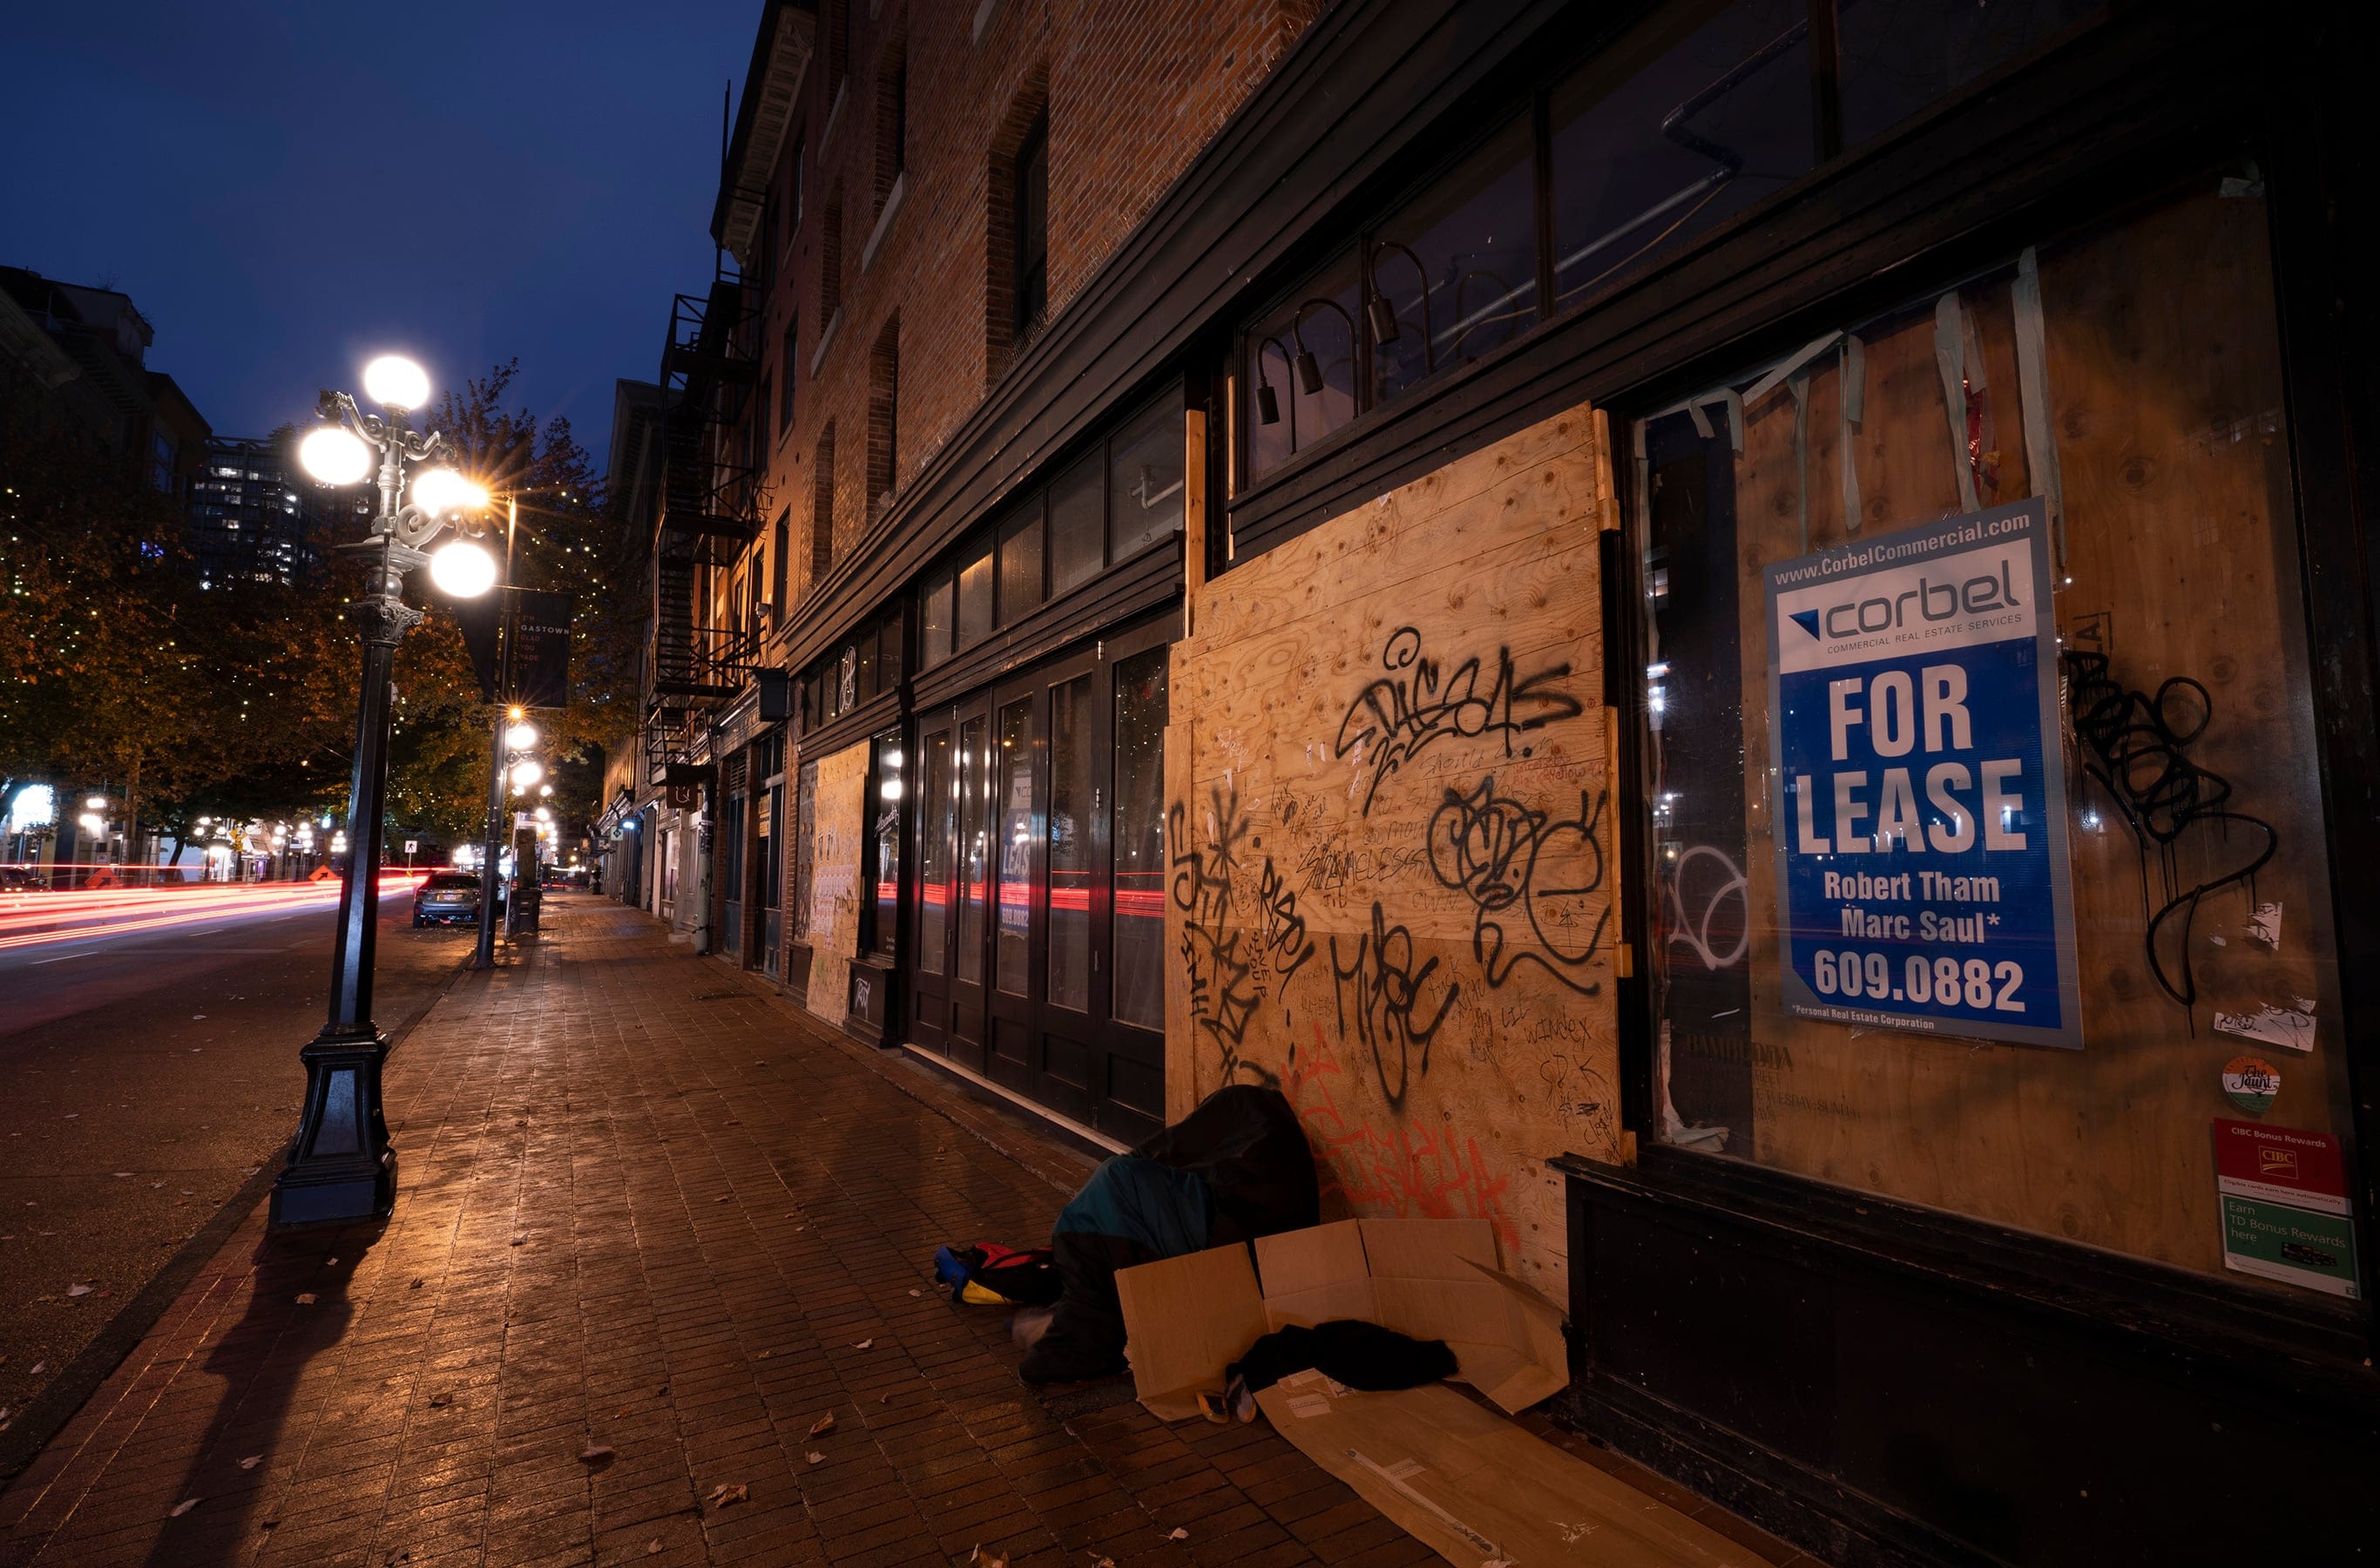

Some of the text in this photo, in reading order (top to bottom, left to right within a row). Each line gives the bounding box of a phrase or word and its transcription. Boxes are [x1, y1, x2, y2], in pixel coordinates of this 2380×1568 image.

[1775, 513, 2031, 586] www.CorbelCommercial.com
[1825, 559, 2022, 639] corbel
[520, 624, 570, 635] GASTOWN
[1827, 613, 2022, 655] COMMERCIAL REAL ESTATE SERVICES
[1829, 663, 1974, 761] FOR
[1795, 758, 2028, 855] LEASE
[1003, 844, 1031, 875] LEAS
[1824, 871, 2000, 902] Robert Tham
[1841, 909, 1910, 940] Marc
[1814, 950, 2025, 1013] 609.0882
[1831, 1008, 1849, 1020] Real
[1851, 1010, 1879, 1024] Estate
[1880, 1013, 1935, 1031] Corporation
[2231, 1072, 2275, 1091] Jaunt
[2243, 1064, 2268, 1078] The
[2230, 1126, 2327, 1148] CIBC Bonus Rewards
[2262, 1149, 2294, 1165] CIBC
[2229, 1201, 2255, 1215] Earn
[2230, 1214, 2346, 1248] TD Bonus Rewards
[2230, 1227, 2257, 1242] here
